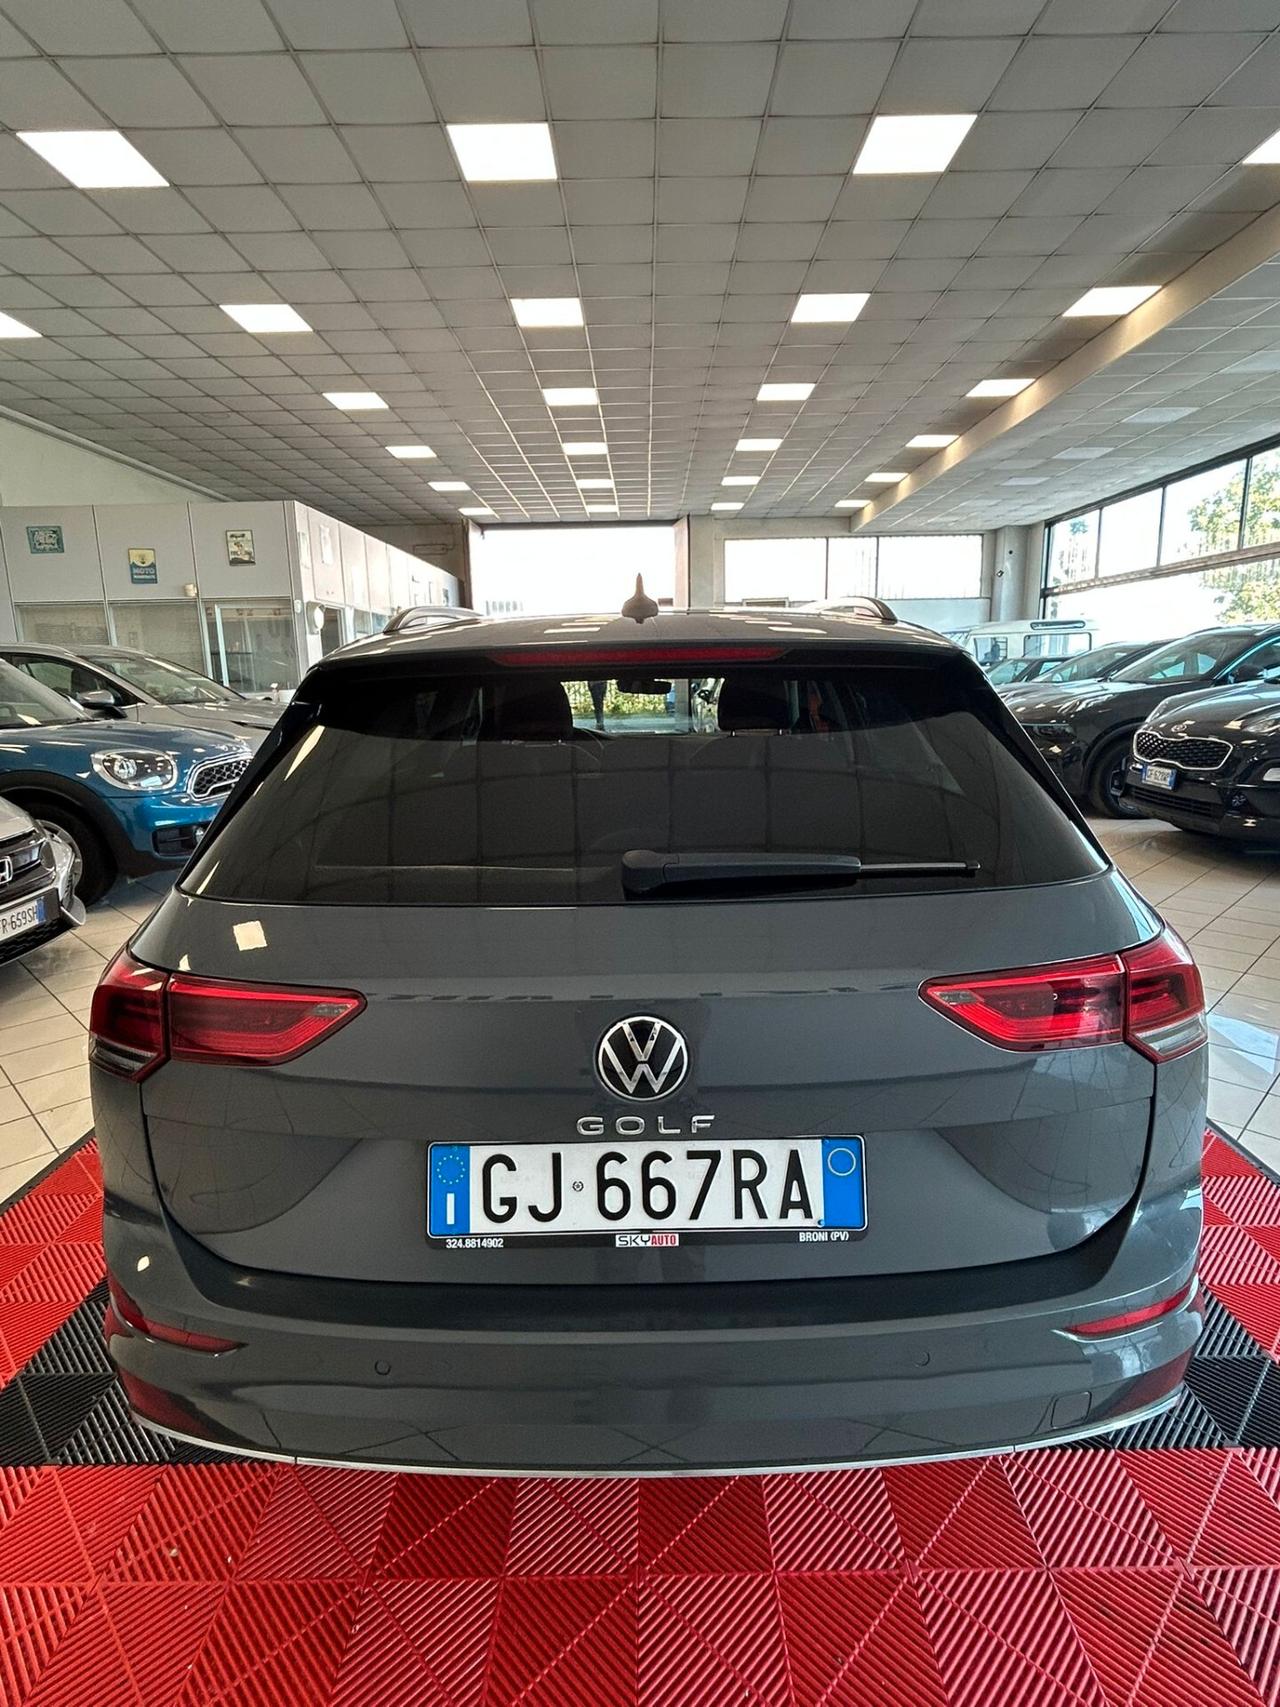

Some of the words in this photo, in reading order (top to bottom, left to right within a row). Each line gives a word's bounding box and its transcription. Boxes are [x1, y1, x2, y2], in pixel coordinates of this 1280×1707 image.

[576, 1114, 716, 1136] GOLF
[482, 1152, 562, 1224] GJ
[596, 1149, 814, 1221] 667RA
[446, 1238, 504, 1249] 324.8814902
[799, 1232, 829, 1243] BRONI
[830, 1230, 850, 1242] (PV)
